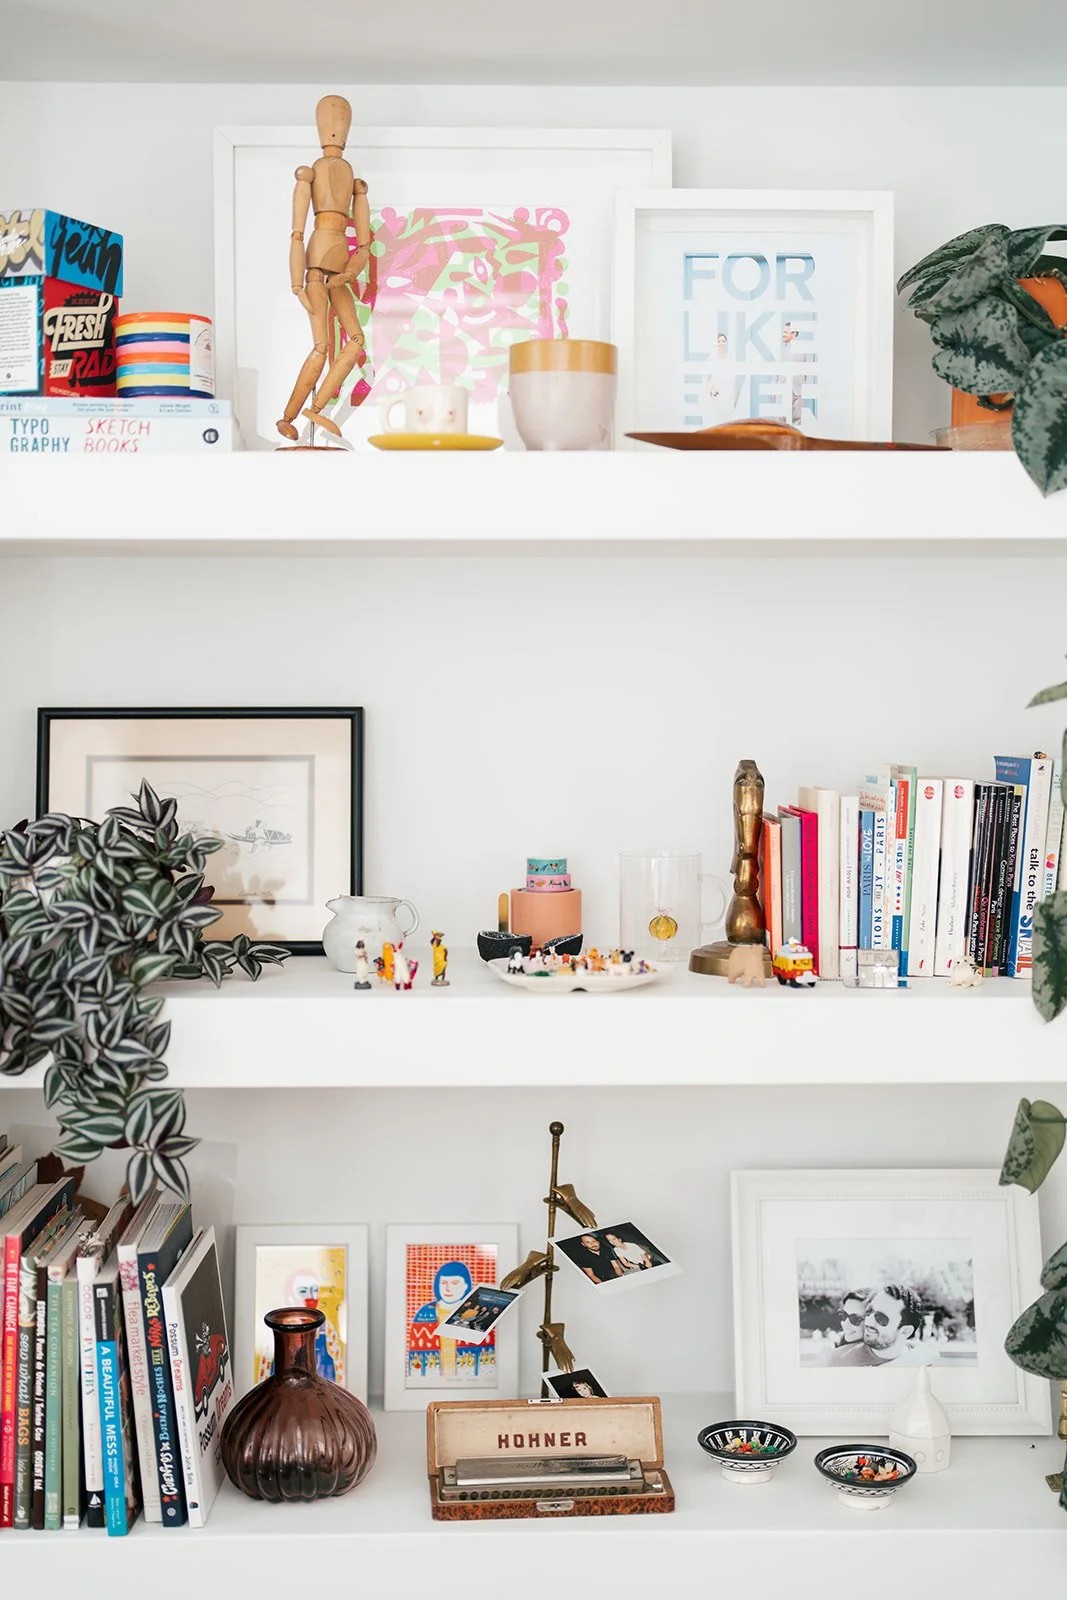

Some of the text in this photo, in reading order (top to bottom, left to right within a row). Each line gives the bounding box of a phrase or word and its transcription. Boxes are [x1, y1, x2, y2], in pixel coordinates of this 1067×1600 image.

[51, 226, 122, 294] yeah
[682, 252, 816, 301] FOR
[43, 292, 113, 352] FRESH
[682, 311, 818, 362] LIKE
[54, 363, 70, 374] STAY
[69, 349, 116, 381] RAD
[10, 418, 50, 435] TYPO
[86, 418, 151, 435] SKETCH
[10, 437, 70, 453] GRAPHY
[84, 438, 139, 453] BOOKS
[876, 818, 885, 854] PARIS
[1010, 828, 1018, 845] Places
[1008, 854, 1016, 866] Kiss
[862, 864, 872, 896] PARIS
[1046, 873, 1054, 899] BETTE
[1017, 848, 1039, 974] talk to the SNAIL
[992, 934, 1000, 960] Parisienne
[6, 1277, 17, 1292] THE
[143, 1271, 160, 1318] REBELDES
[5, 1296, 17, 1332] CHANGE
[36, 1300, 45, 1336] ESTAMBUL
[82, 1285, 92, 1320] COLOR
[36, 1338, 45, 1360] Puerta
[50, 1294, 58, 1396] THE TEA COMPANION
[128, 1302, 147, 1396] flea market style
[168, 1323, 184, 1392] Possum Dreams
[36, 1361, 44, 1370] de
[84, 1338, 94, 1395] PATTERN
[18, 1333, 30, 1446] sew what! BAGS
[36, 1372, 44, 1396] Oriente
[101, 1346, 117, 1456] A BEAUTIFUL MESS
[154, 1366, 168, 1403] NOCHES
[157, 1404, 170, 1440] BUENAS
[498, 1432, 587, 1449] HOHNER
[34, 1450, 44, 1477] ORIENT
